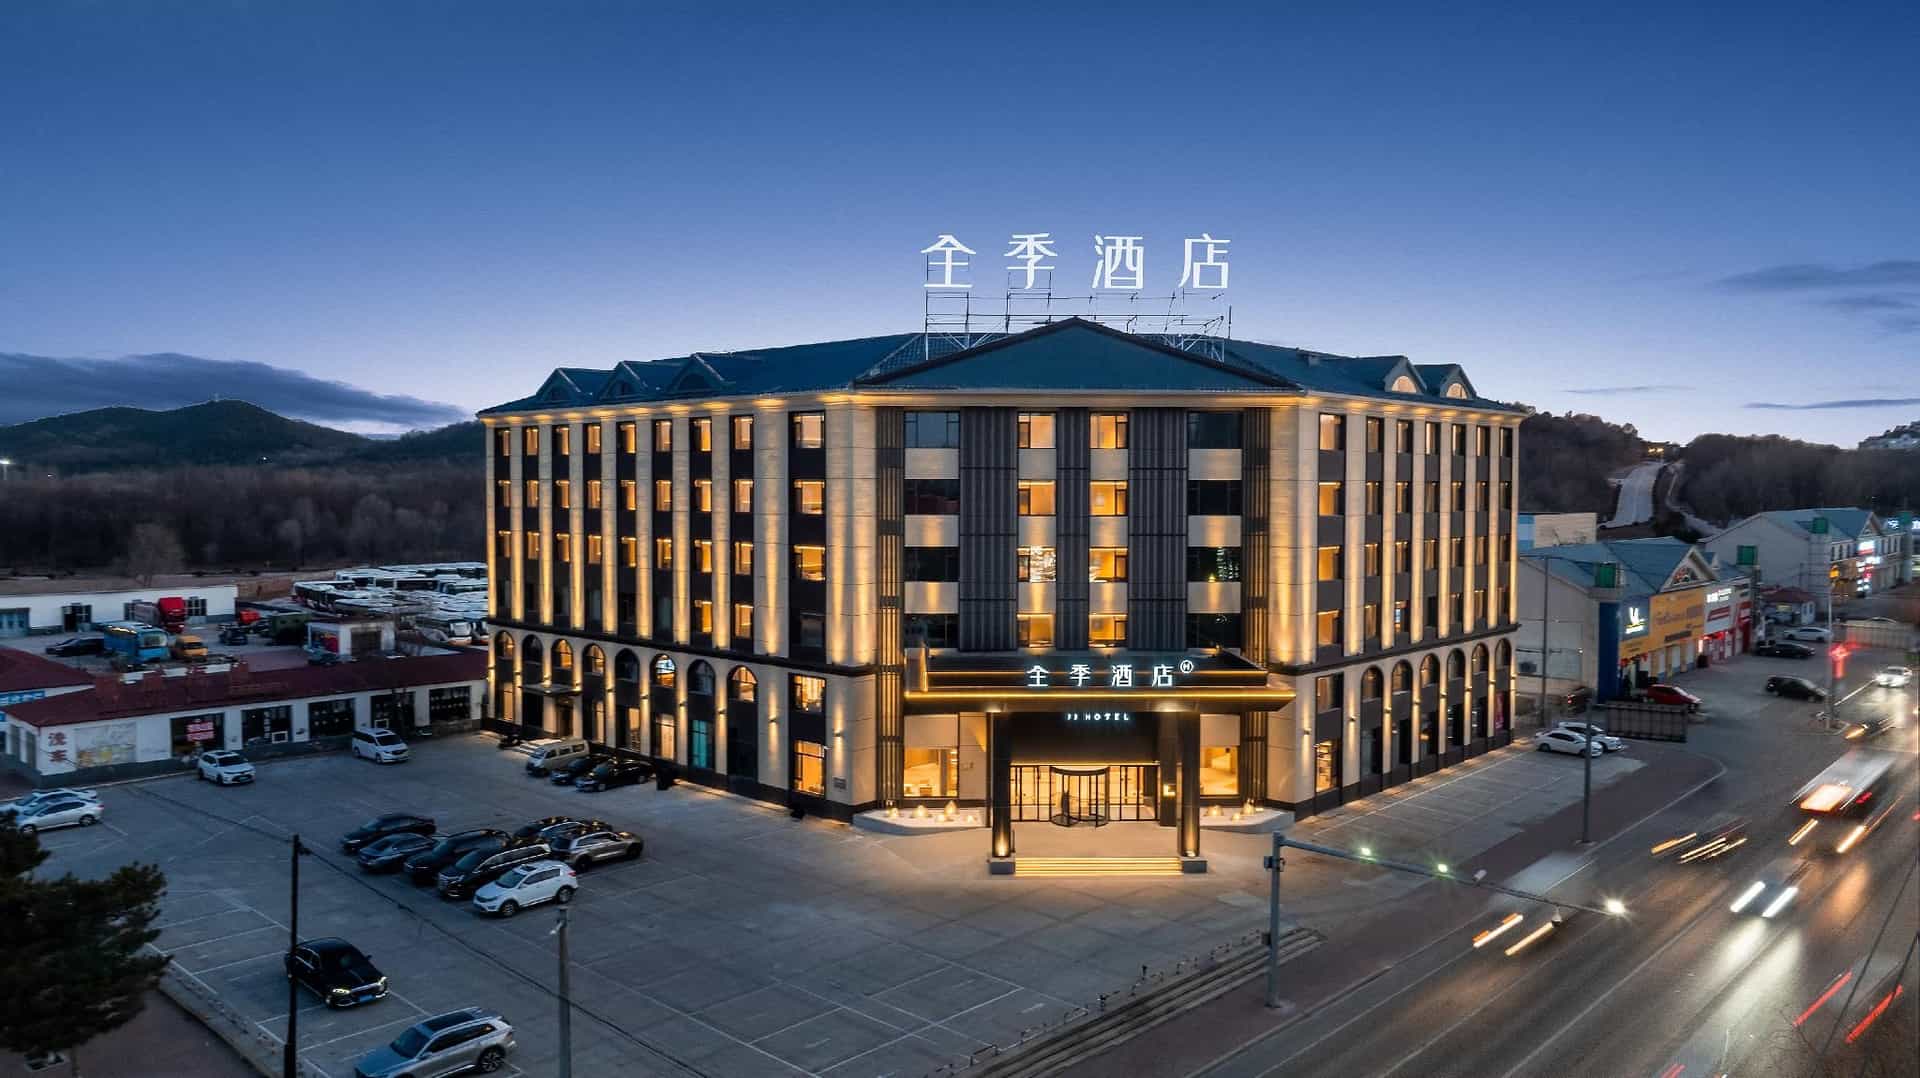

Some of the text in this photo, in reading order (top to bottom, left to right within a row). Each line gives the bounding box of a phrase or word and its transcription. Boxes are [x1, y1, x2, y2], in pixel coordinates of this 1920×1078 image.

[920, 232, 1232, 290] 全季酒店
[1026, 664, 1174, 688] 全季酒店
[1085, 712, 1129, 721] HOTEL
